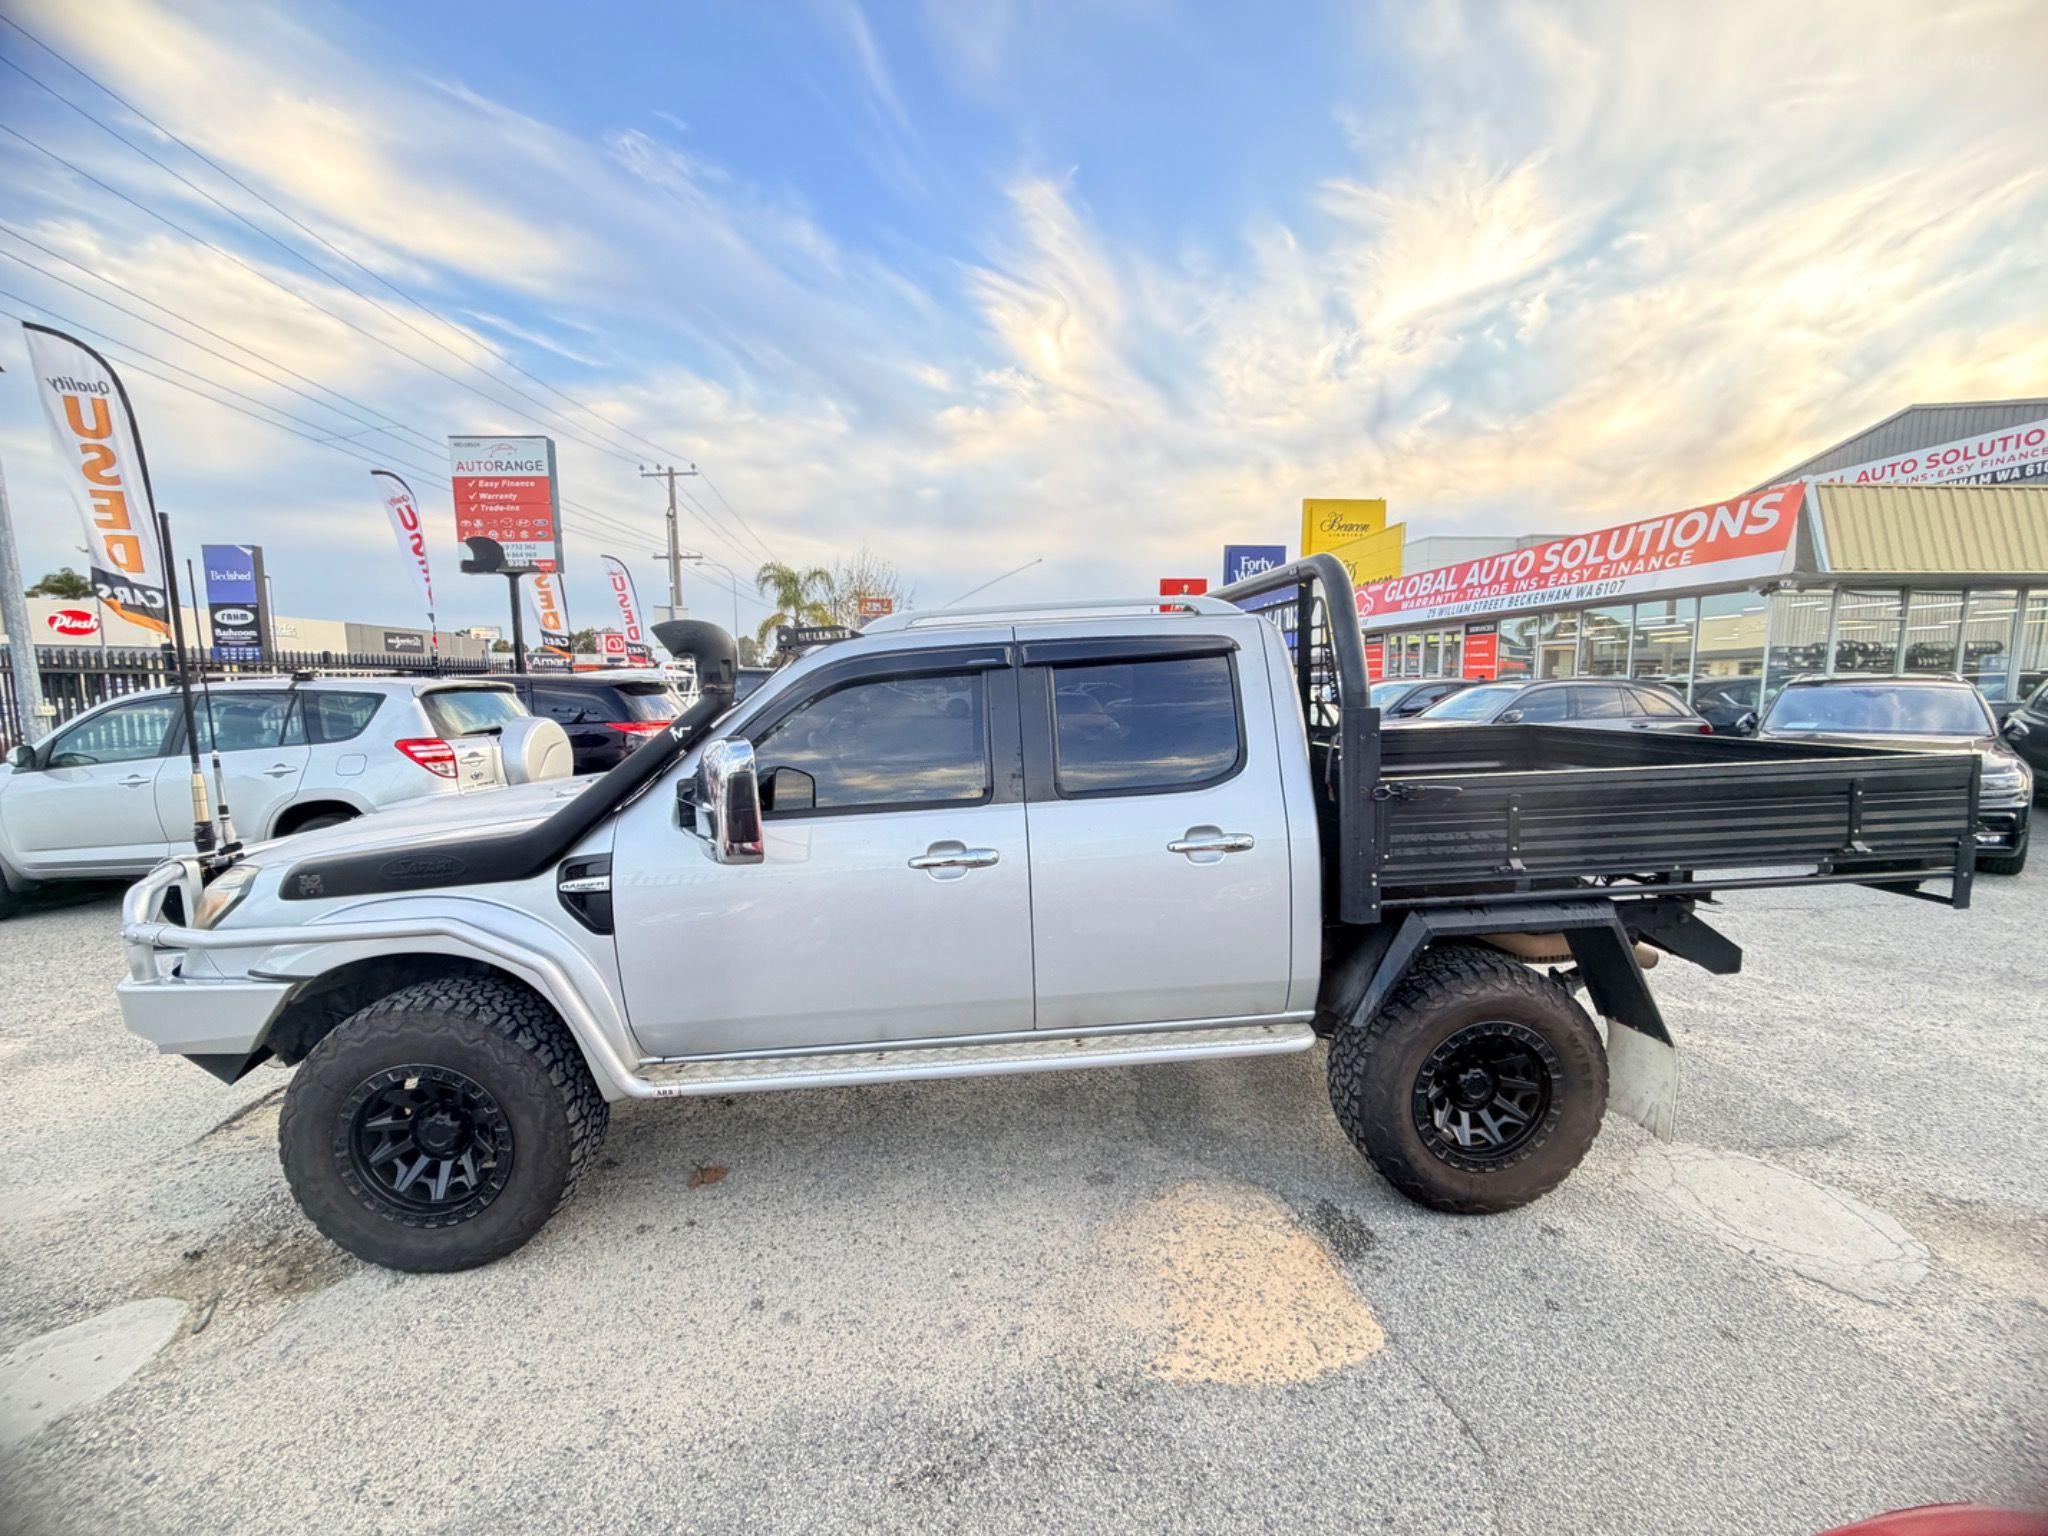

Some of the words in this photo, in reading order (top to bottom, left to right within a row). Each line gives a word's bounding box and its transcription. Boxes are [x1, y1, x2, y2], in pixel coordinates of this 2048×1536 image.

[456, 460, 544, 471] AUTORANGE
[1857, 459, 1918, 484] AUTO
[1936, 463, 1974, 478] EASY
[478, 480, 498, 488] Easy
[1320, 511, 1370, 532] Beacon
[1384, 567, 1458, 602] GLOBAL
[1462, 550, 1535, 588] AUTO
[1540, 493, 1784, 573] SOLUTIONS
[1240, 556, 1274, 570] Forty
[1401, 592, 1458, 609] WARRANTY
[1466, 583, 1508, 599] TRADE
[1513, 577, 1538, 591] INS
[1548, 570, 1592, 586] EASY
[1598, 549, 1694, 578] FINANCE
[1438, 602, 1471, 616] WILLIAM
[1472, 598, 1505, 612] STREET
[1508, 588, 1571, 607] BECKENHAM
[1576, 585, 1593, 598] WA
[1595, 580, 1625, 596] 6107
[51, 612, 99, 632] Plush
